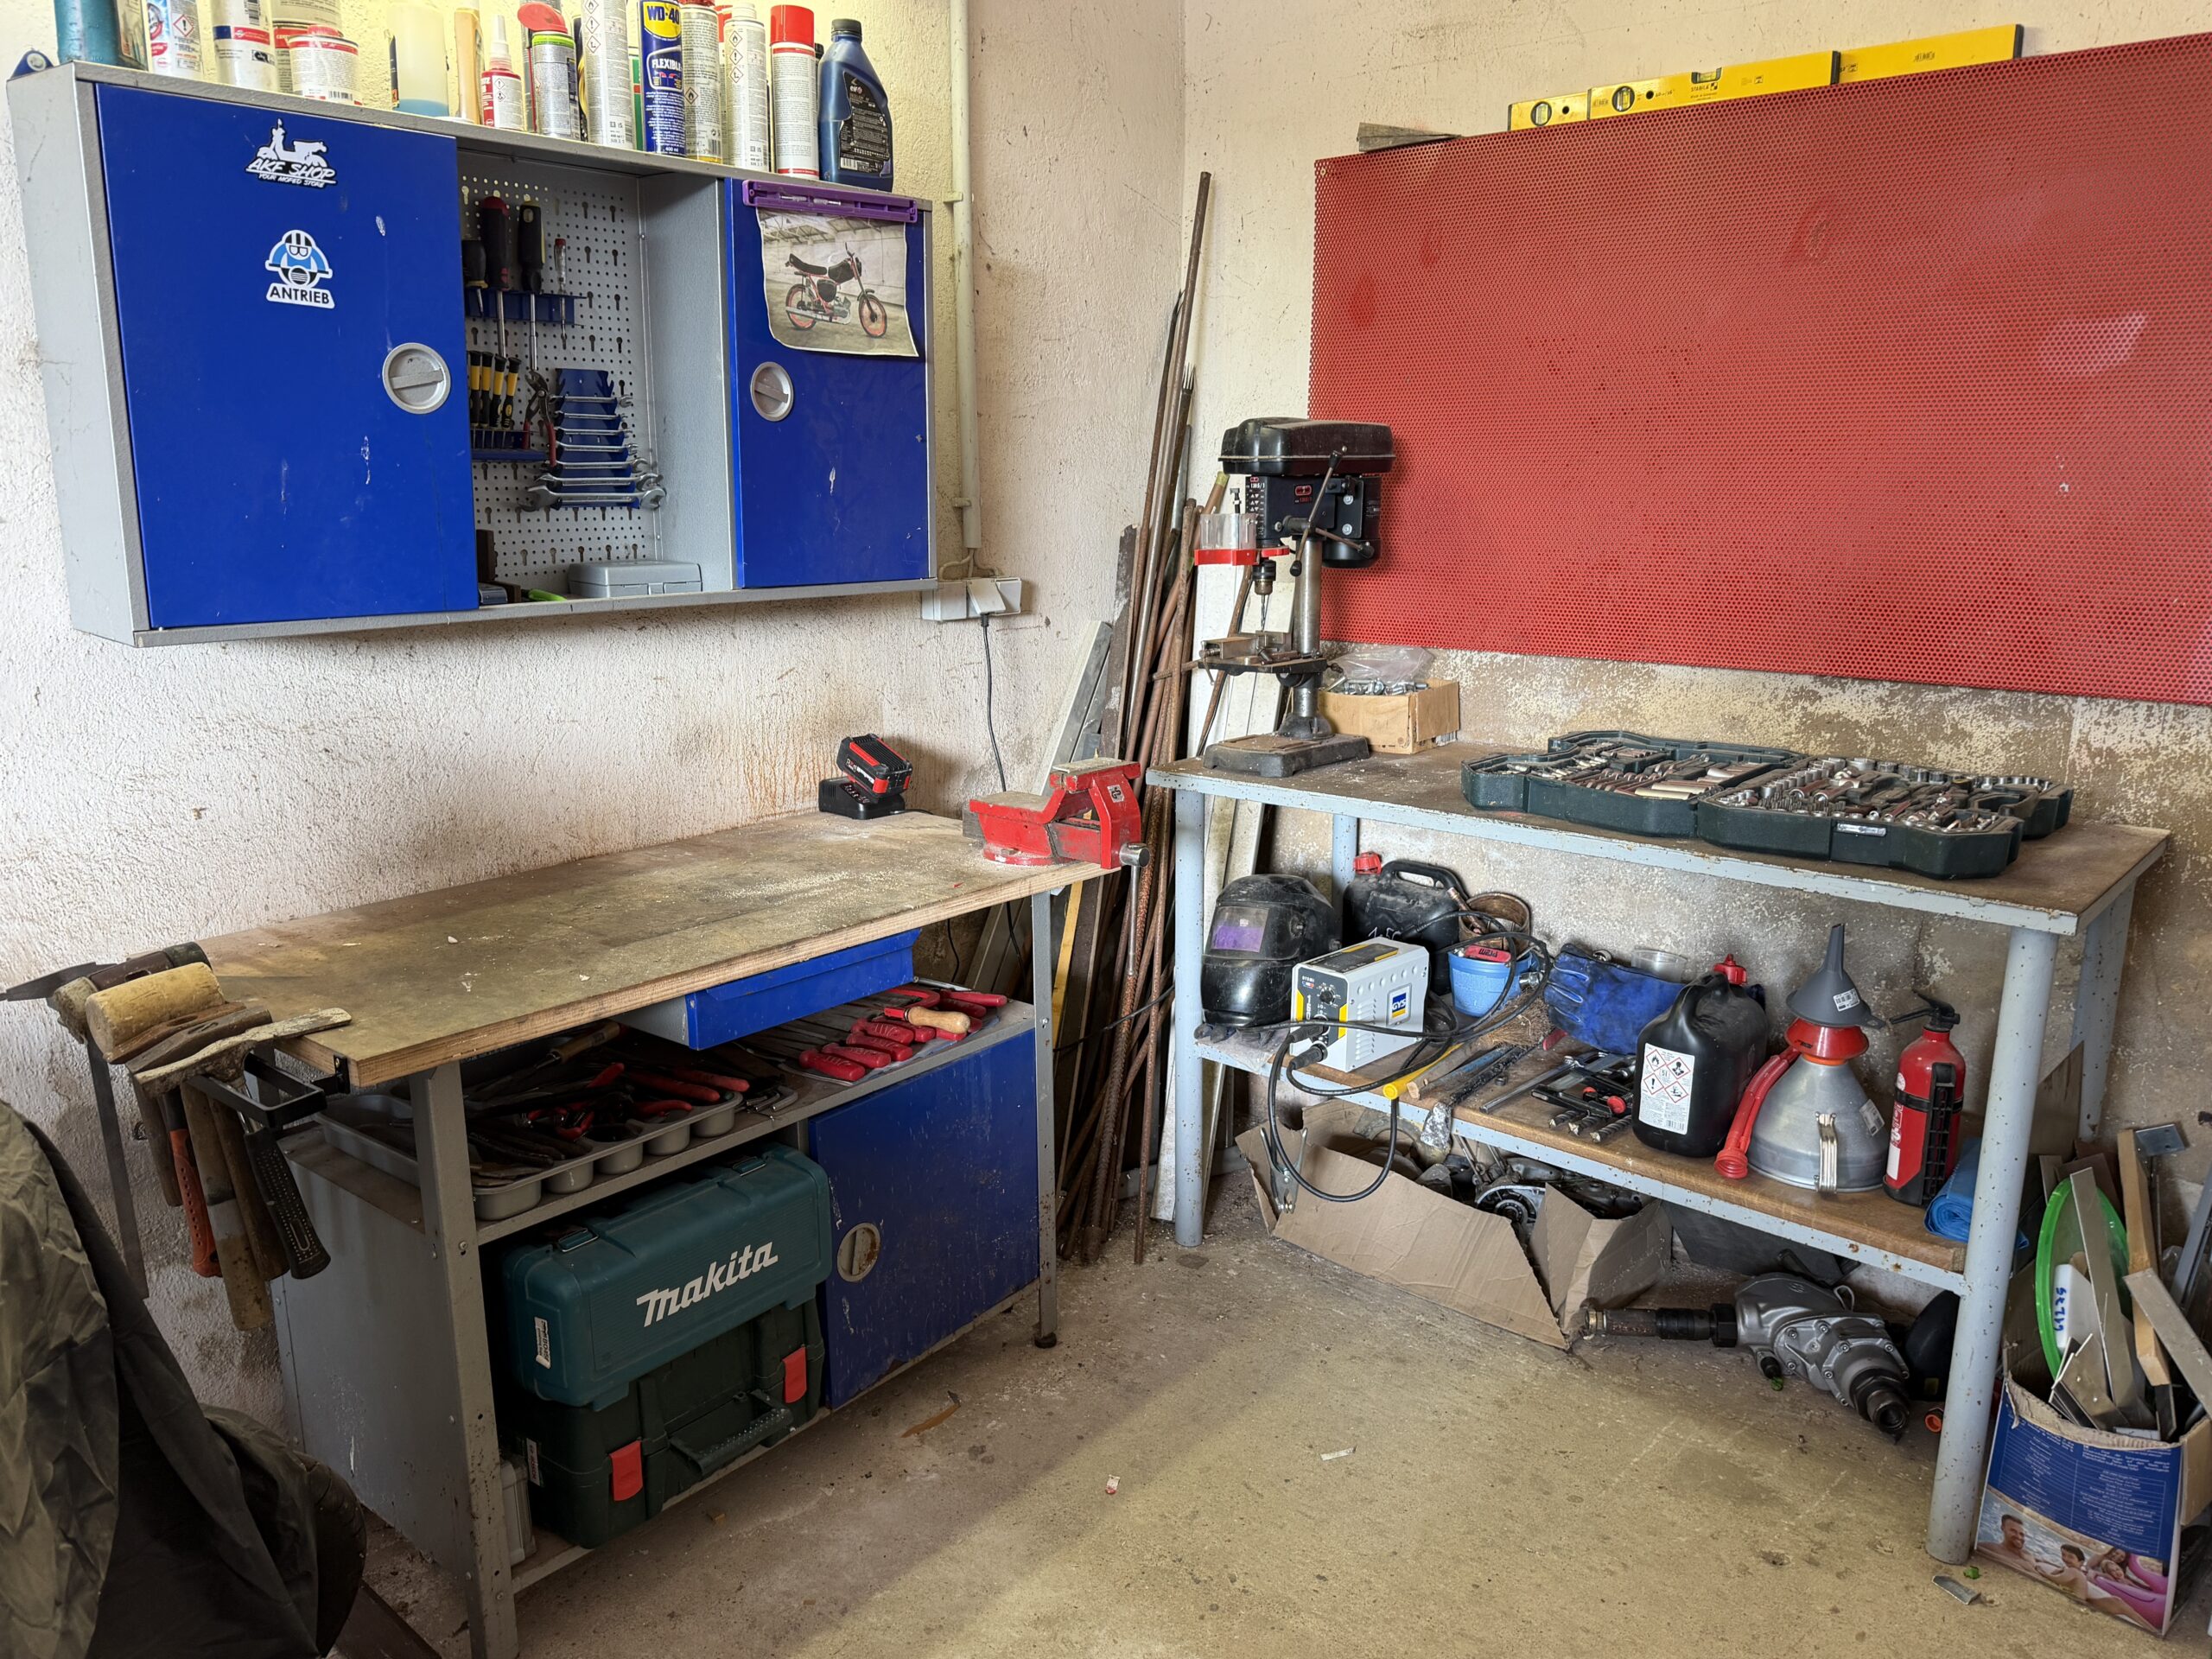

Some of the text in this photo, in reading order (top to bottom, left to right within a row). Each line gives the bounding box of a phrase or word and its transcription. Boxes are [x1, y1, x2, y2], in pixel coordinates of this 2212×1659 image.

[646, 5, 680, 25] WD-40
[248, 158, 336, 180] AKF SHOP
[303, 180, 326, 188] STORE
[269, 285, 330, 305] ANTRIEB
[1392, 998, 1407, 1011] GYS
